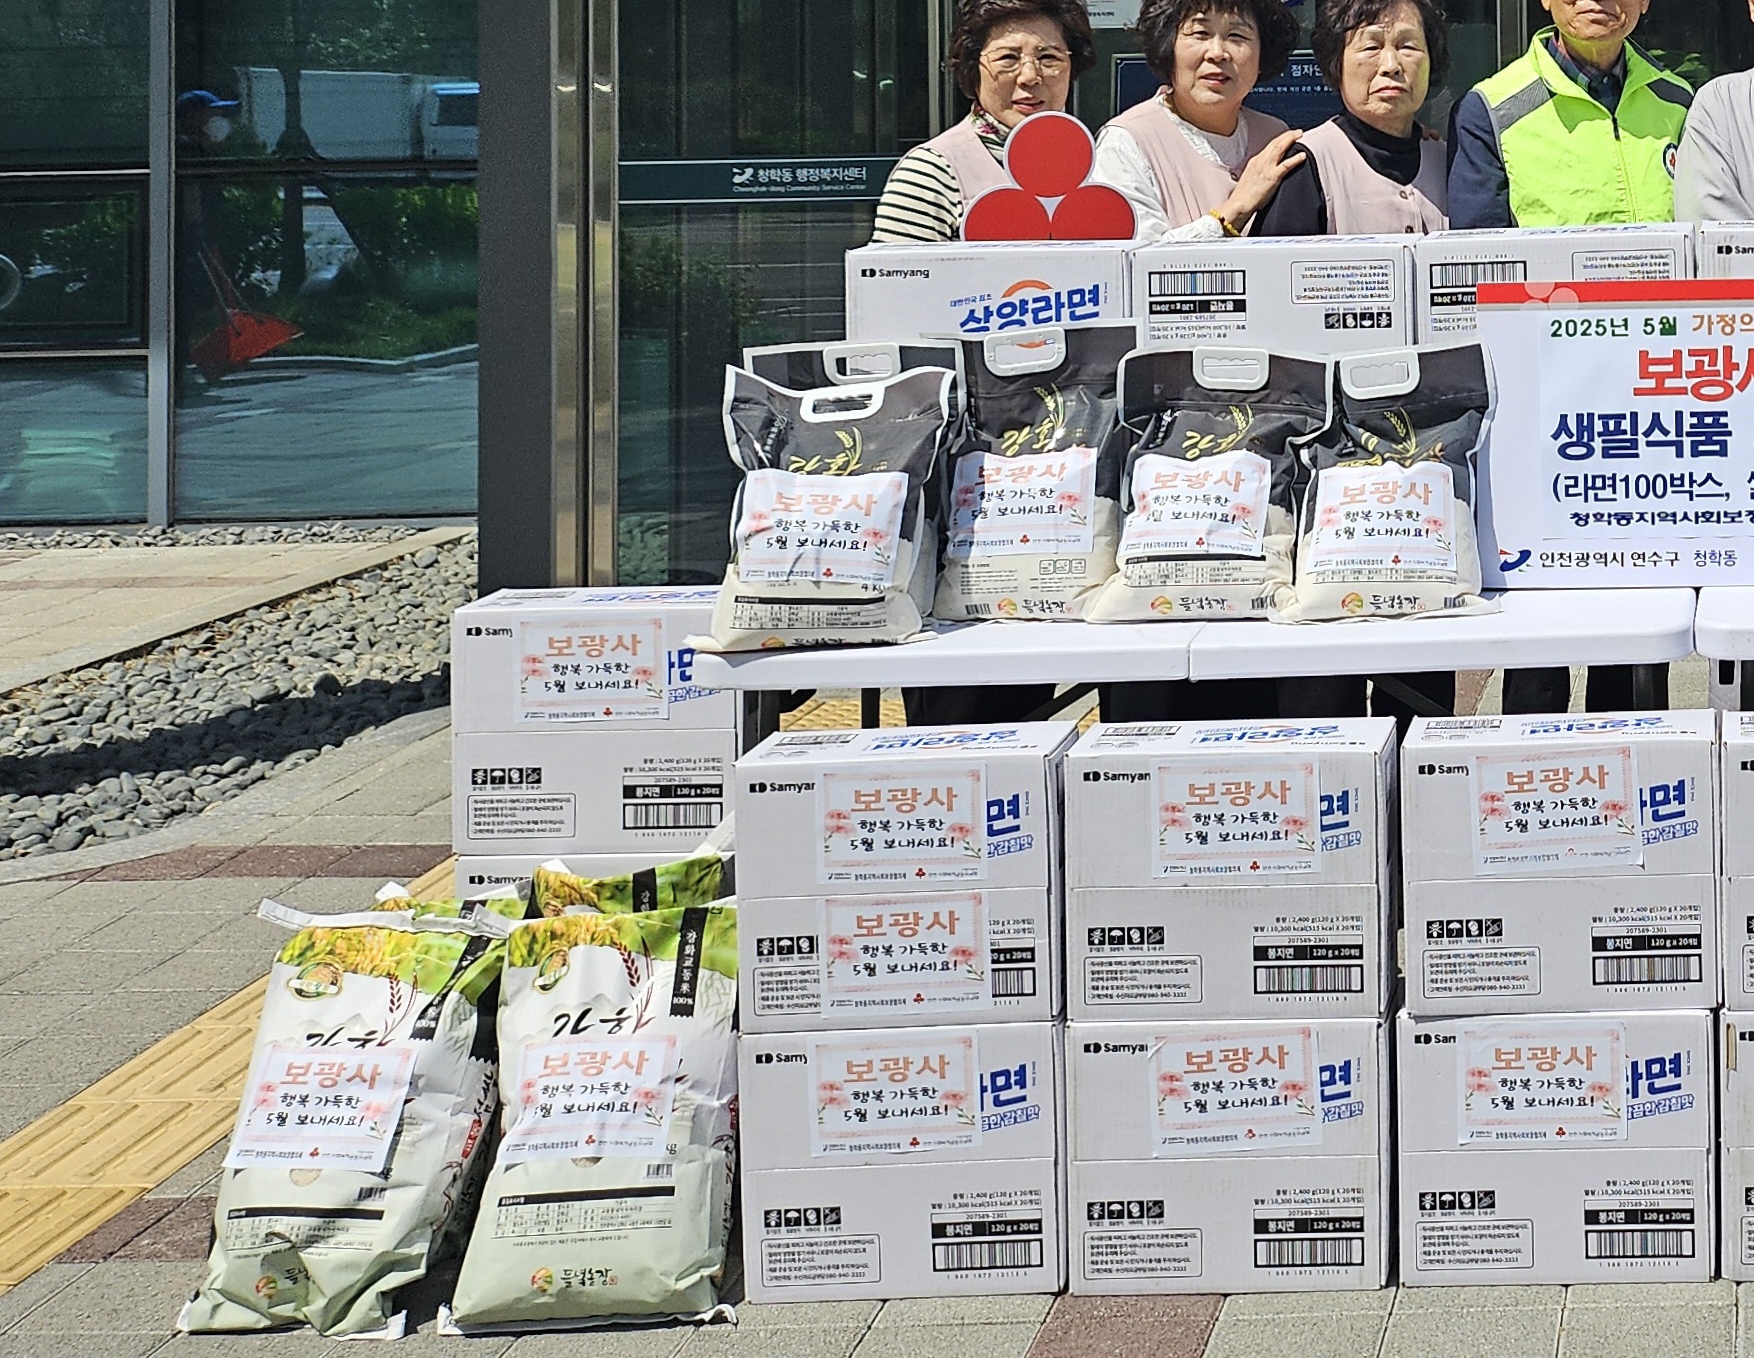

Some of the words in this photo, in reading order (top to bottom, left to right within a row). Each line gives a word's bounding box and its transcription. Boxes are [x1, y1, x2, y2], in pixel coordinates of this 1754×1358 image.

[756, 168, 794, 182] 청학동
[795, 166, 866, 182] 행정복지센터
[878, 268, 930, 279] Samyang
[959, 283, 1101, 333] 삼양라면
[1551, 316, 1630, 337] 2025년
[1643, 316, 1678, 336] 5월
[1551, 409, 1733, 460] 생필식품
[1339, 480, 1433, 506] 보광사
[1552, 469, 1730, 502] (라면100박스,
[772, 491, 878, 516] 보광사
[1343, 509, 1373, 523] 행복
[1377, 508, 1422, 523] 가득한
[774, 519, 807, 534] 행복
[812, 520, 861, 534] 가득한
[1334, 526, 1356, 540] 5월
[1362, 527, 1430, 540] 보내세요!
[766, 535, 792, 550] 5월
[796, 537, 868, 551] 보내세요!
[1539, 551, 1625, 568] 인천광역시
[1630, 550, 1680, 566] 연수구
[1693, 550, 1738, 567] 청학동
[545, 634, 642, 657] 보광사
[552, 663, 581, 676] 행복
[587, 662, 631, 675] 가득한
[544, 681, 566, 692] 5월
[574, 679, 639, 690] 보내세요!
[851, 786, 958, 813] 보광사
[857, 819, 891, 832] 행복
[897, 818, 945, 831] 가득한
[850, 837, 875, 852] 5월
[884, 836, 955, 849] 보내세요!
[1267, 947, 1294, 959] 봉지면
[279, 1060, 382, 1090] 보광사
[280, 1092, 311, 1107] 행복
[314, 1093, 363, 1109] 가득한
[266, 1111, 288, 1127] 5월
[295, 1112, 365, 1128] 보내세요!
